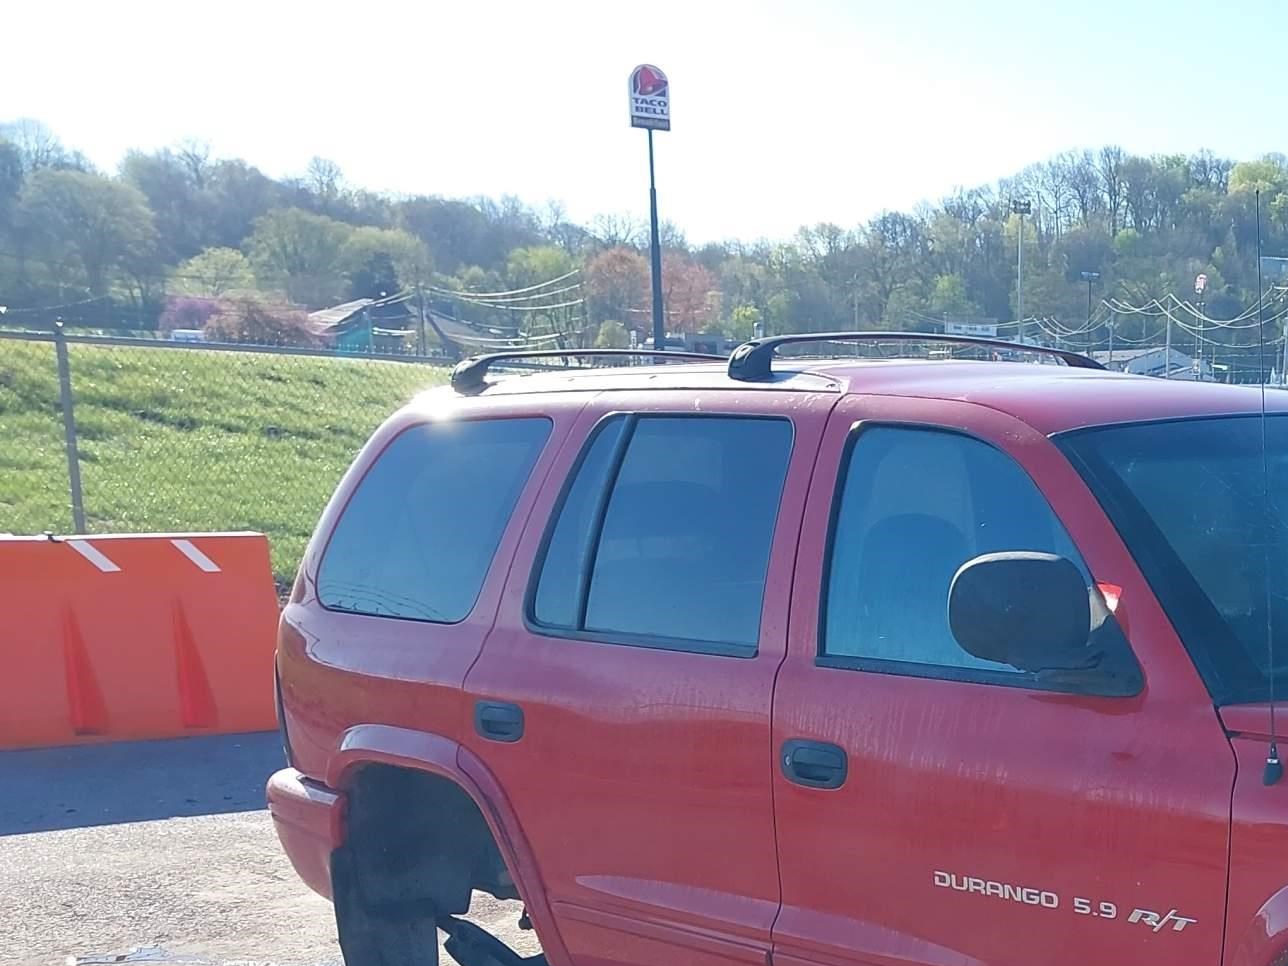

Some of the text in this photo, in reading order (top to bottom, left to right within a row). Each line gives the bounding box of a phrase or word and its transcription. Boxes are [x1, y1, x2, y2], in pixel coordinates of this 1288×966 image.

[632, 97, 668, 108] TACO
[635, 106, 668, 116] BELL
[933, 870, 1198, 933] DURANGO 5.9 R/T
